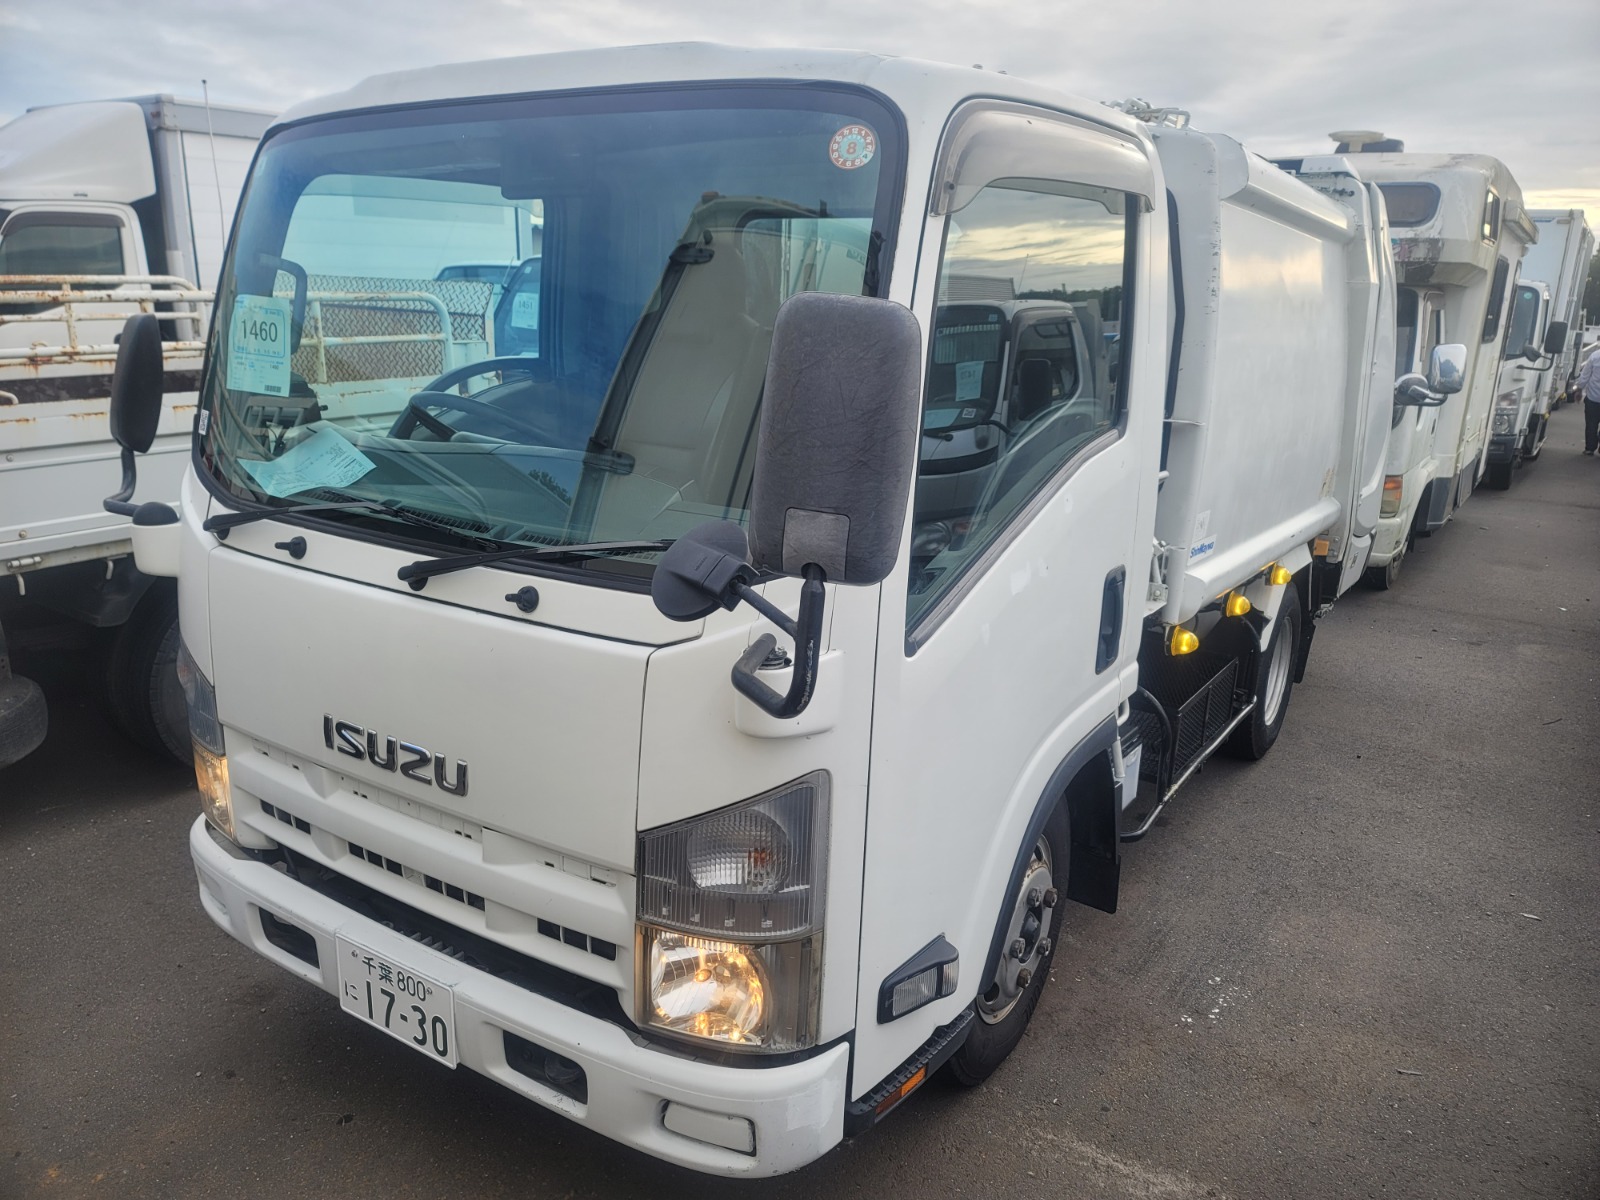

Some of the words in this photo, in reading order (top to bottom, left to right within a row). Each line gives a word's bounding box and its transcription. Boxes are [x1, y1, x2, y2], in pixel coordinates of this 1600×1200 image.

[846, 142, 857, 154] 8
[241, 319, 278, 343] 1460
[323, 713, 469, 797] ISUZU
[344, 979, 359, 1001] に
[366, 980, 448, 1057] 17-30
